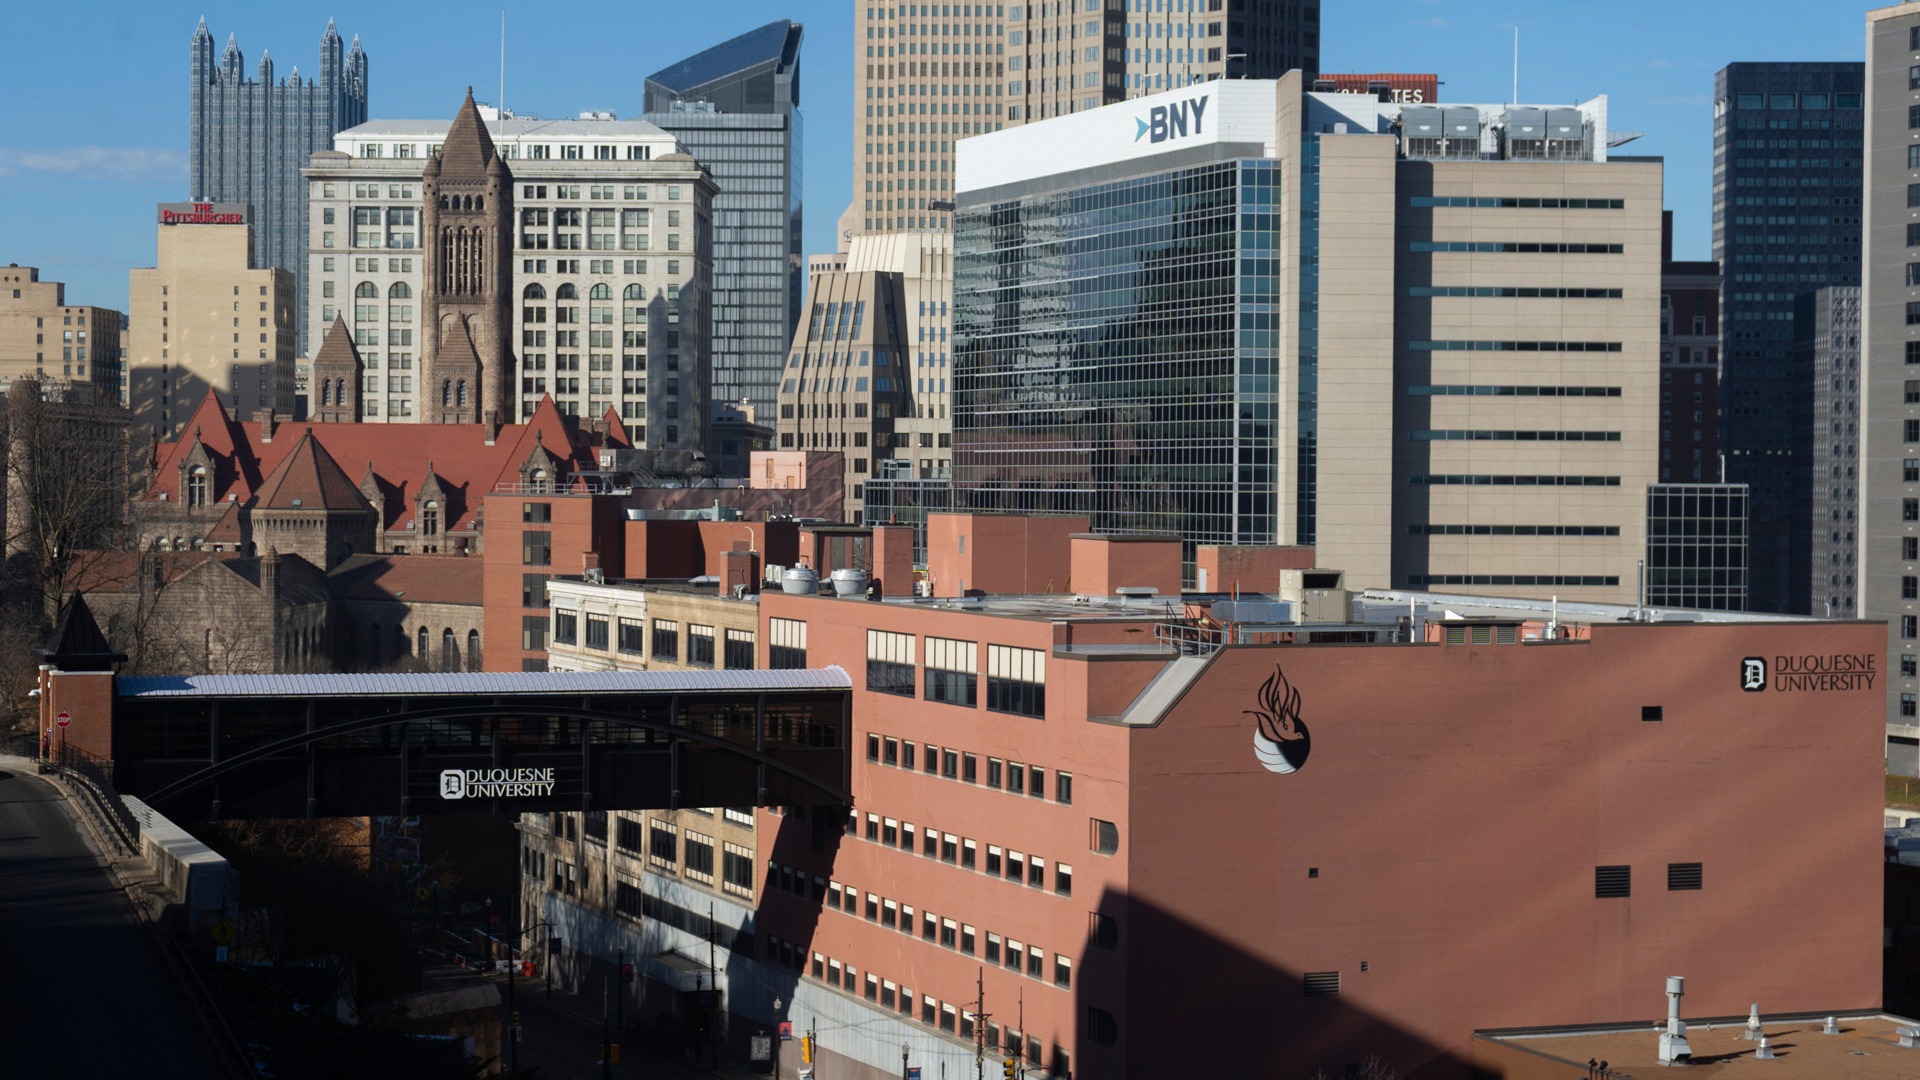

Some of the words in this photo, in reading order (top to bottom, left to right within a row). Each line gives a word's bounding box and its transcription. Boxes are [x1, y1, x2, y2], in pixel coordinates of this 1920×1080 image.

[1151, 95, 1208, 143] BNY
[193, 203, 213, 213] THE
[1775, 654, 1875, 673] DUQUESNE
[1775, 674, 1875, 691] UNIVERSITY
[466, 768, 554, 785] DUQUESNE
[466, 783, 554, 798] UNIVERSITY
